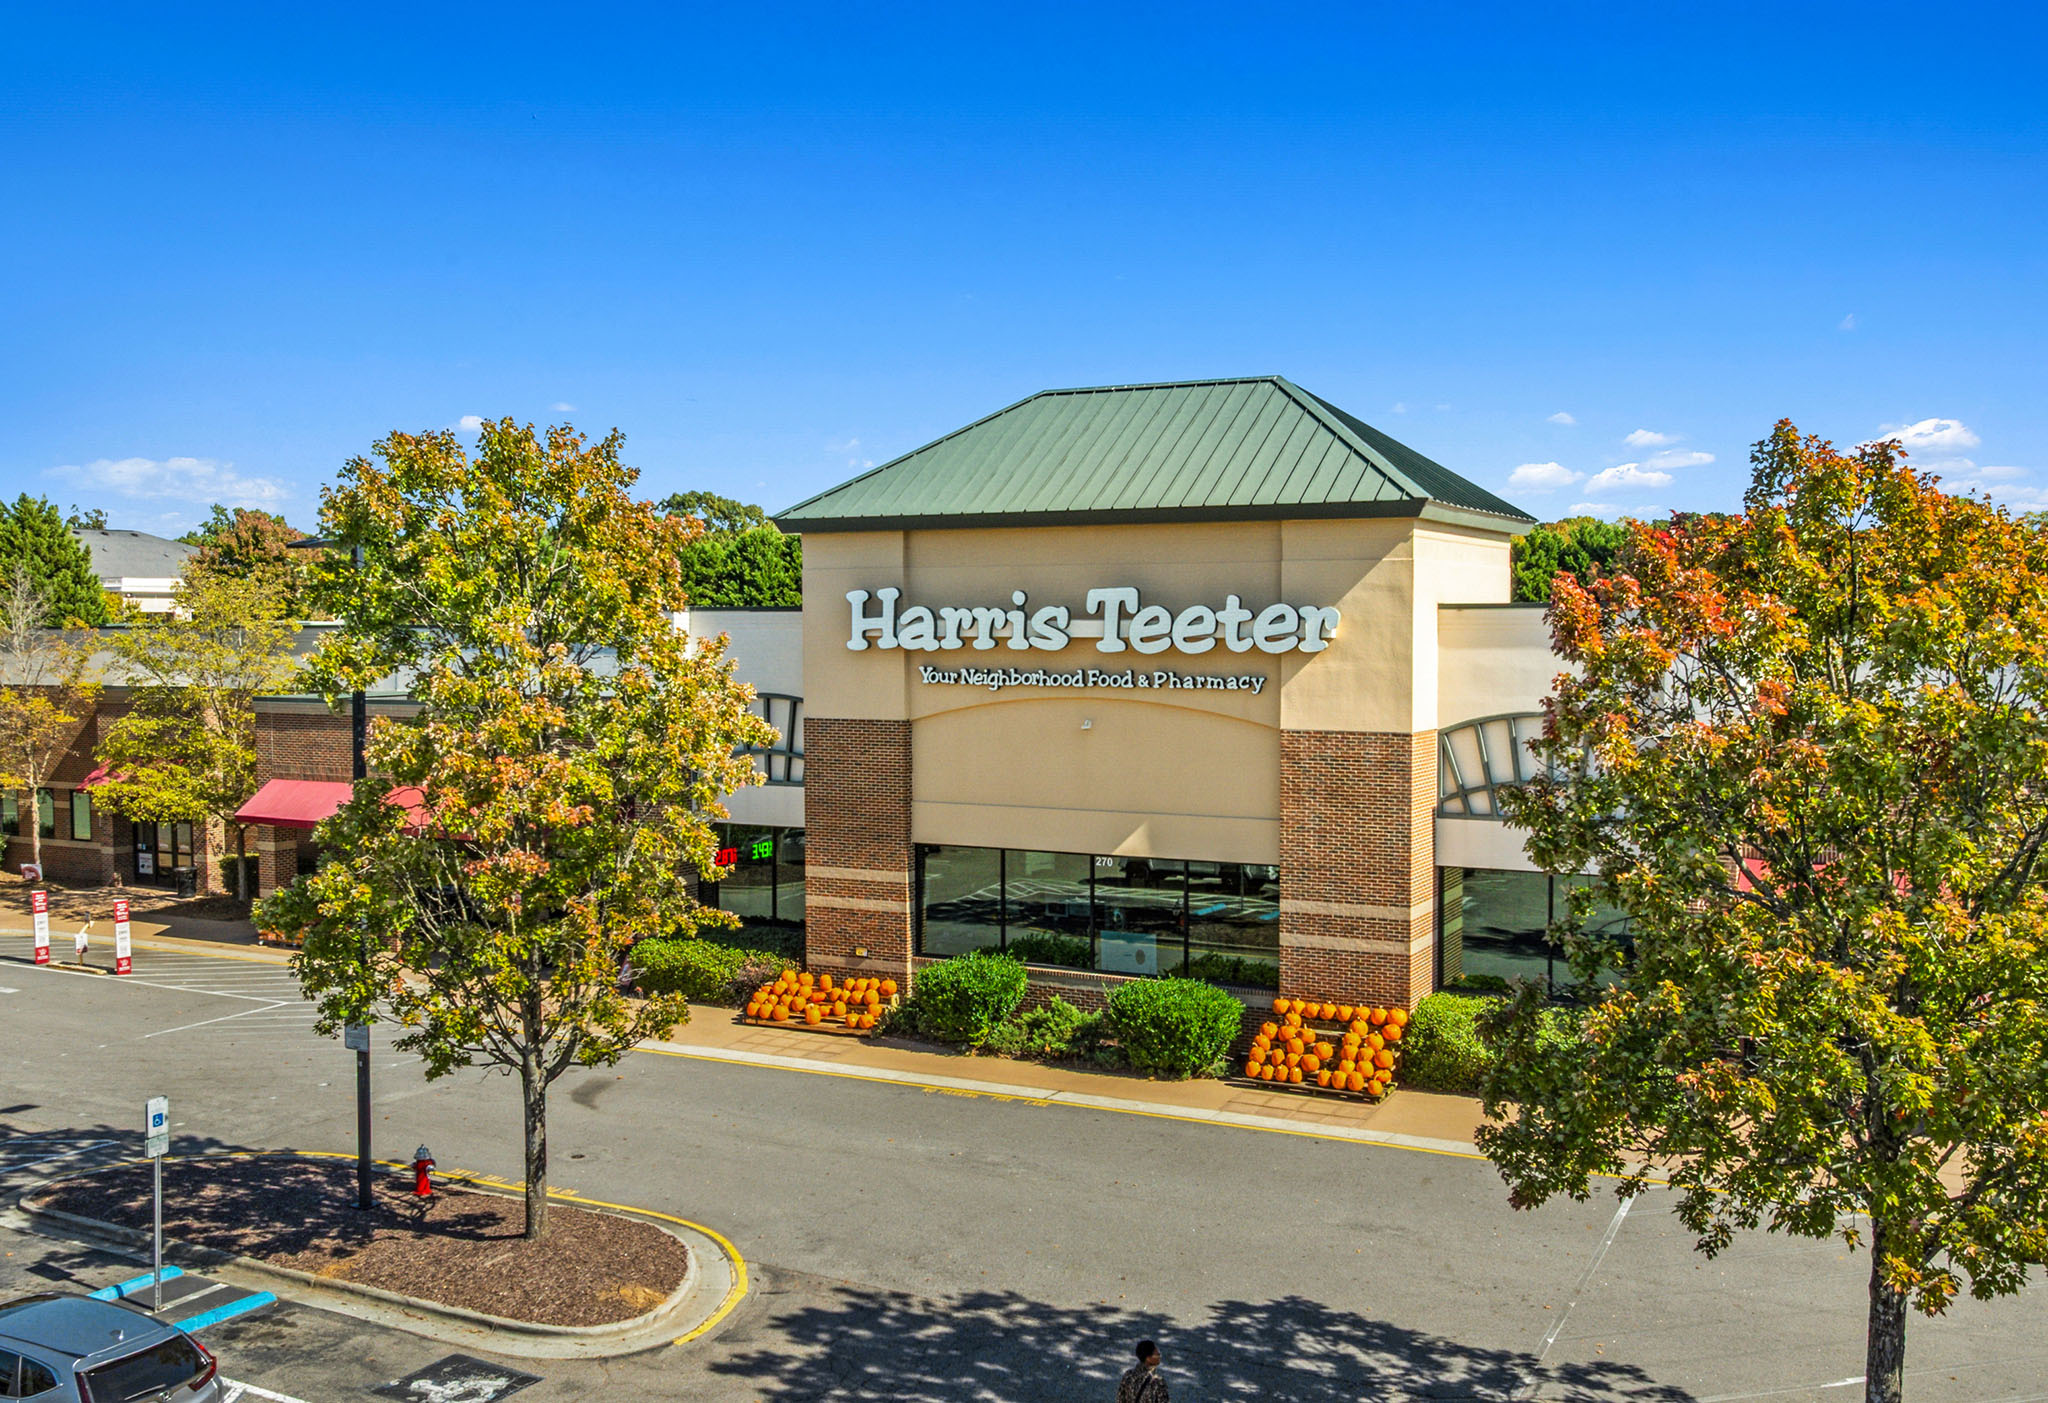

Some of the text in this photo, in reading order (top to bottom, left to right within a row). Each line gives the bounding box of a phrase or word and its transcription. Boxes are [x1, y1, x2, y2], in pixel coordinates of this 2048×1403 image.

[846, 587, 1341, 655] Harris Teeter
[919, 666, 1266, 695] Your Neighborhood Food & Pharmacy
[1096, 857, 1112, 867] 270
